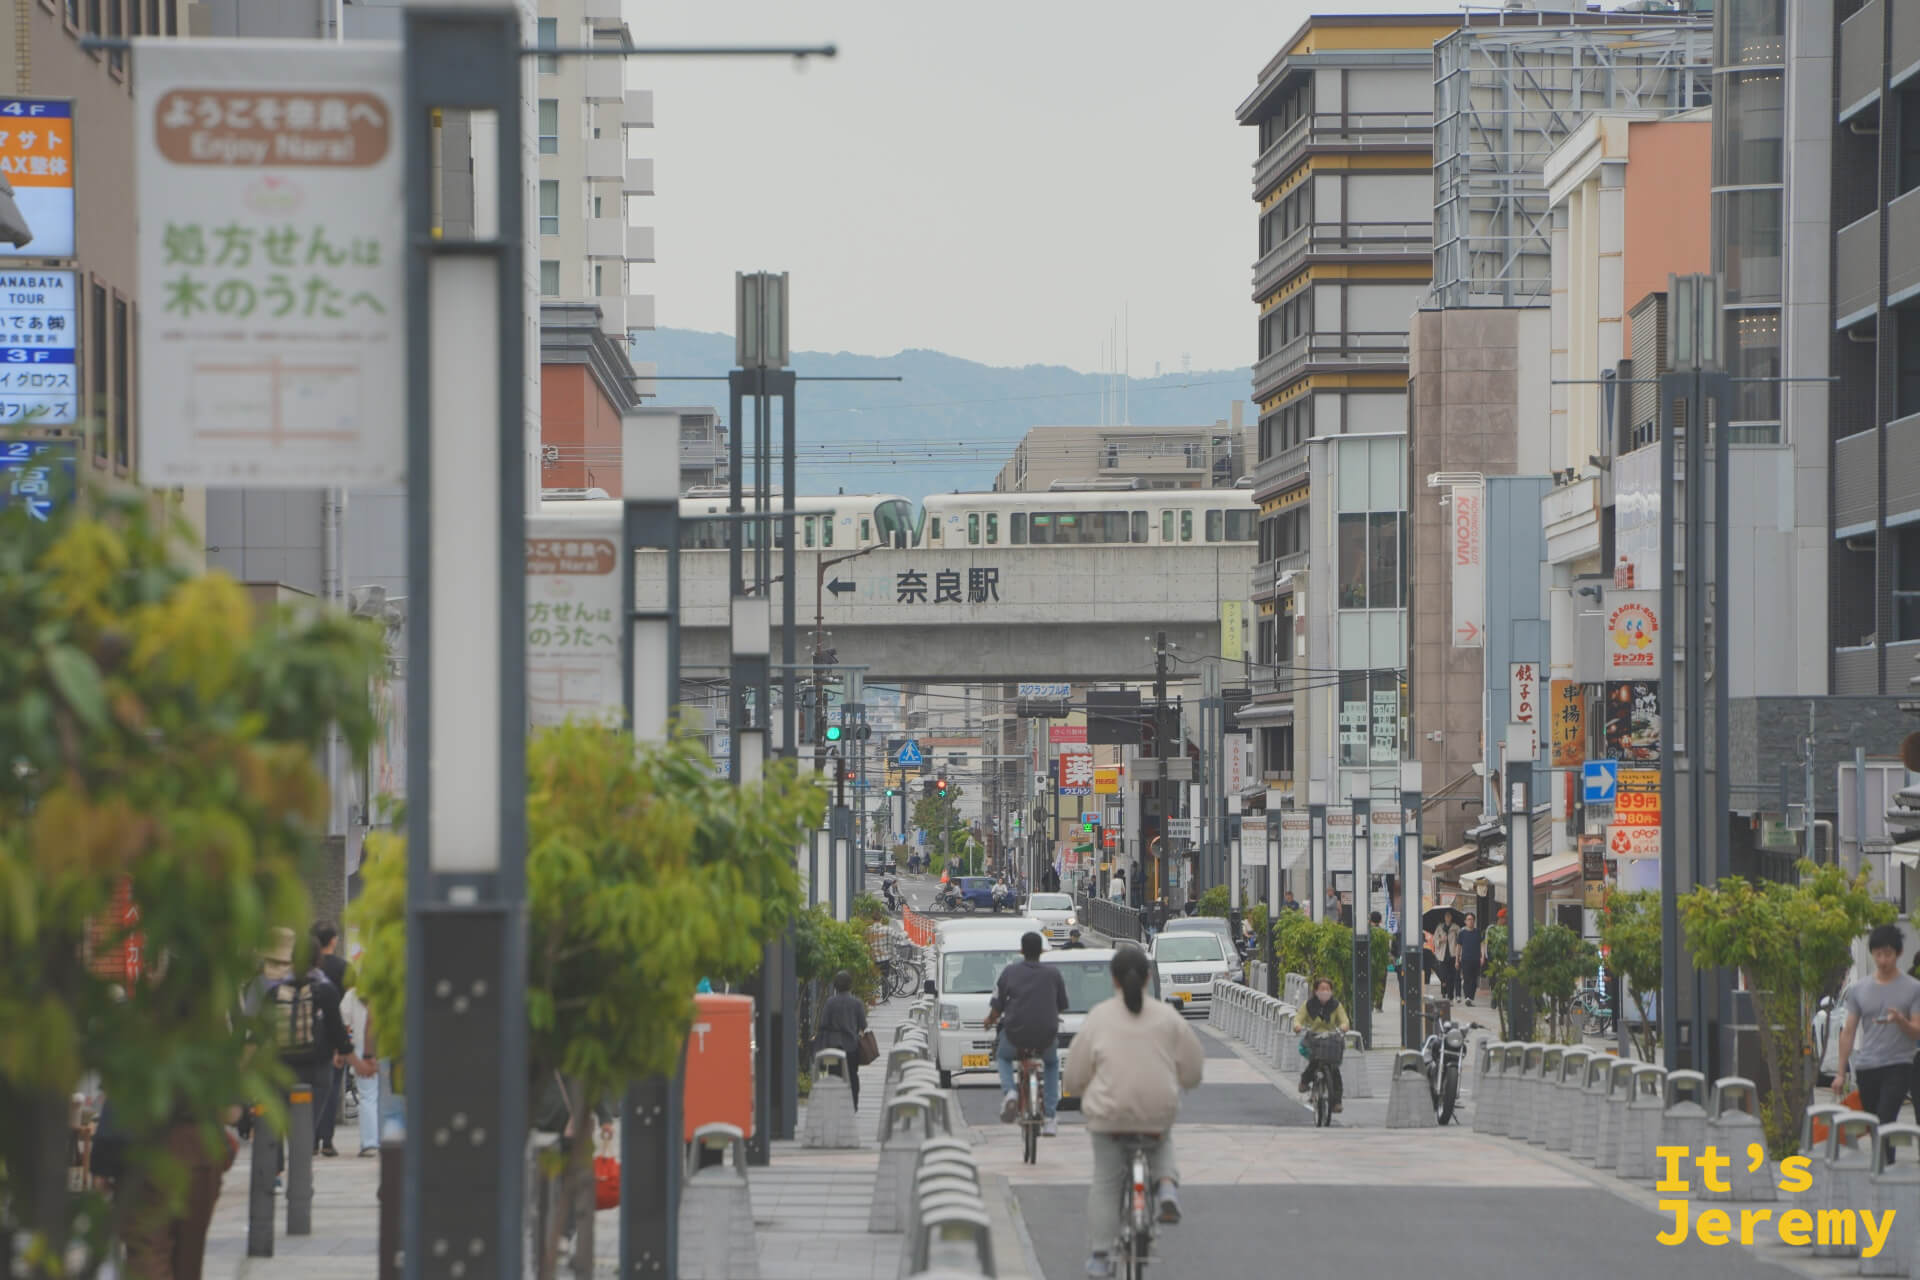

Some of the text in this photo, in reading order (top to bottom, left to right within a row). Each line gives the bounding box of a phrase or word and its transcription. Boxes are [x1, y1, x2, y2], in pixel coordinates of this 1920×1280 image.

[163, 96, 383, 130] ようこそ奈良へ
[190, 131, 269, 163] Enjoy
[163, 222, 381, 268] 処方せんは
[9, 293, 45, 304] TOUR
[163, 273, 386, 319] 木のうたへ
[8, 349, 49, 362] 3F
[896, 567, 1000, 604] 奈良駅
[1562, 684, 1580, 741] 串揚げ
[1065, 755, 1093, 785] 薬
